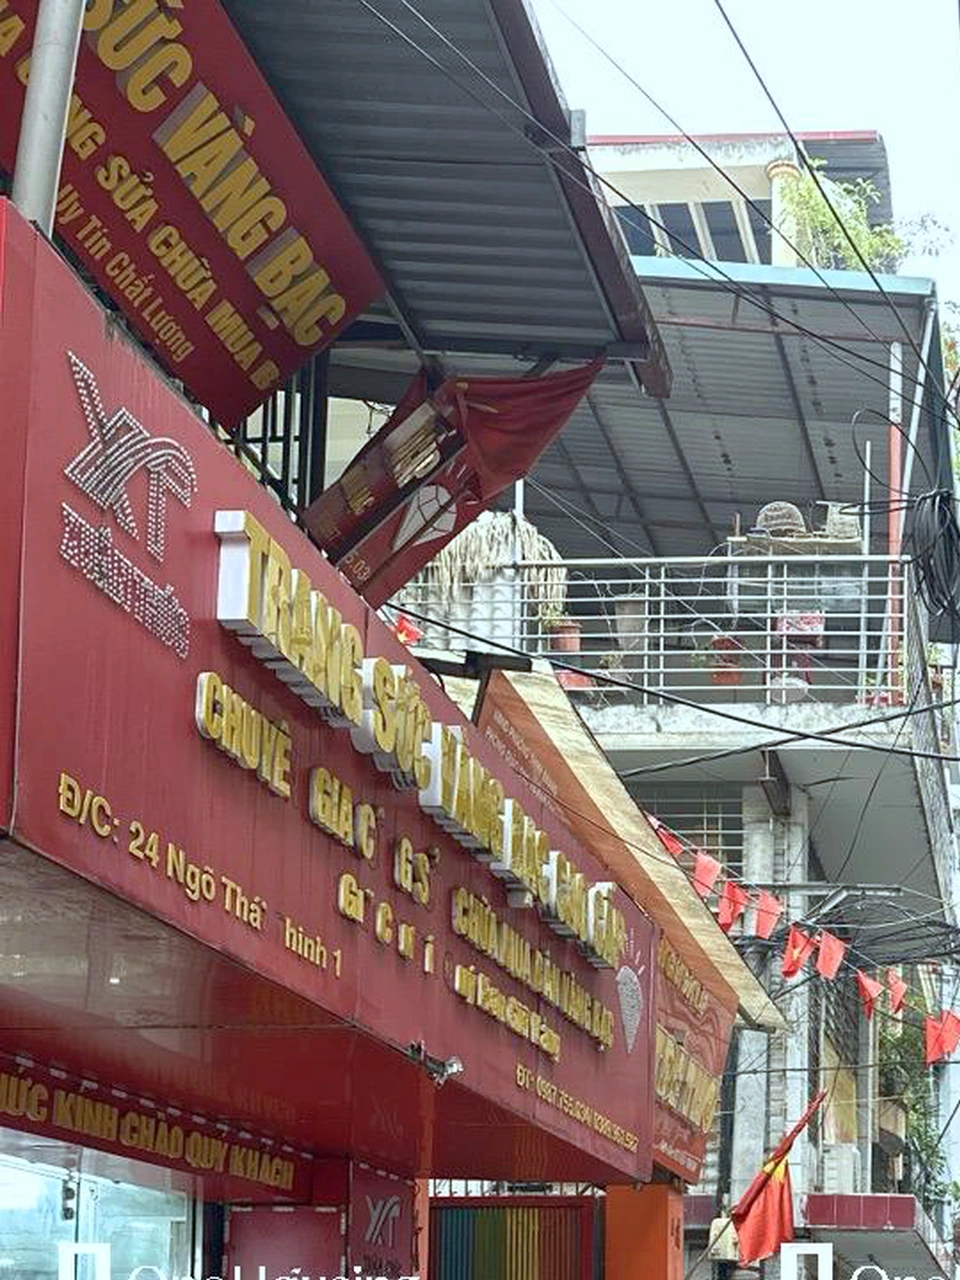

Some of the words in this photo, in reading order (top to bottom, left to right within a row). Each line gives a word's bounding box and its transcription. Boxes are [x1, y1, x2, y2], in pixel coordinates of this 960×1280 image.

[76, 215, 113, 260] Tín
[105, 252, 155, 308] Chất
[141, 298, 195, 363] Lượng
[96, 153, 159, 233] SỬA
[148, 224, 217, 312] CHỮA
[204, 299, 263, 371] MUA
[160, 85, 287, 260] VÀNG
[254, 236, 346, 346] BẠC
[215, 509, 364, 727] TRANG
[128, 821, 160, 868] 24
[166, 842, 216, 901] Ngõ
[333, 948, 341, 978] 1
[119, 1110, 184, 1158] CHÀO
